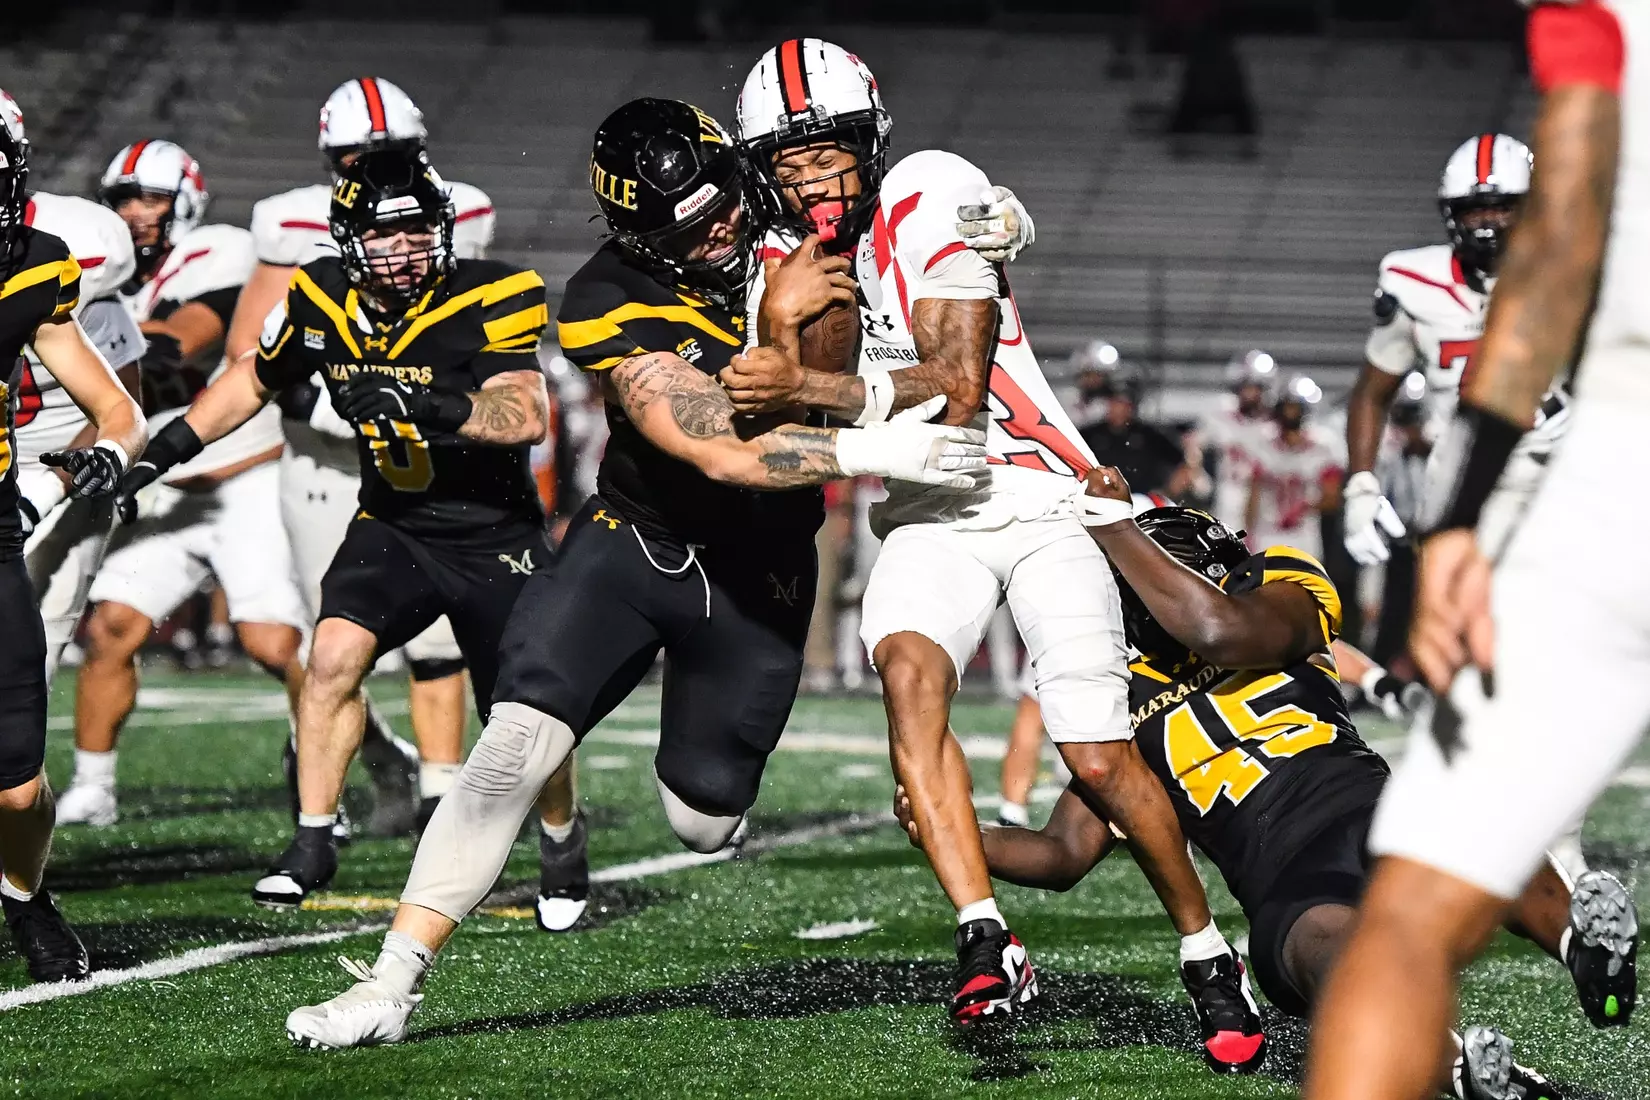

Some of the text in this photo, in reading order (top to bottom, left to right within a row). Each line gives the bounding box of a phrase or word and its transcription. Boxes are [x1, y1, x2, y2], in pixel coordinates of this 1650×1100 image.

[679, 187, 713, 215] Riddell
[498, 548, 536, 576] M
[766, 572, 802, 607] M
[1163, 671, 1338, 818] 45
